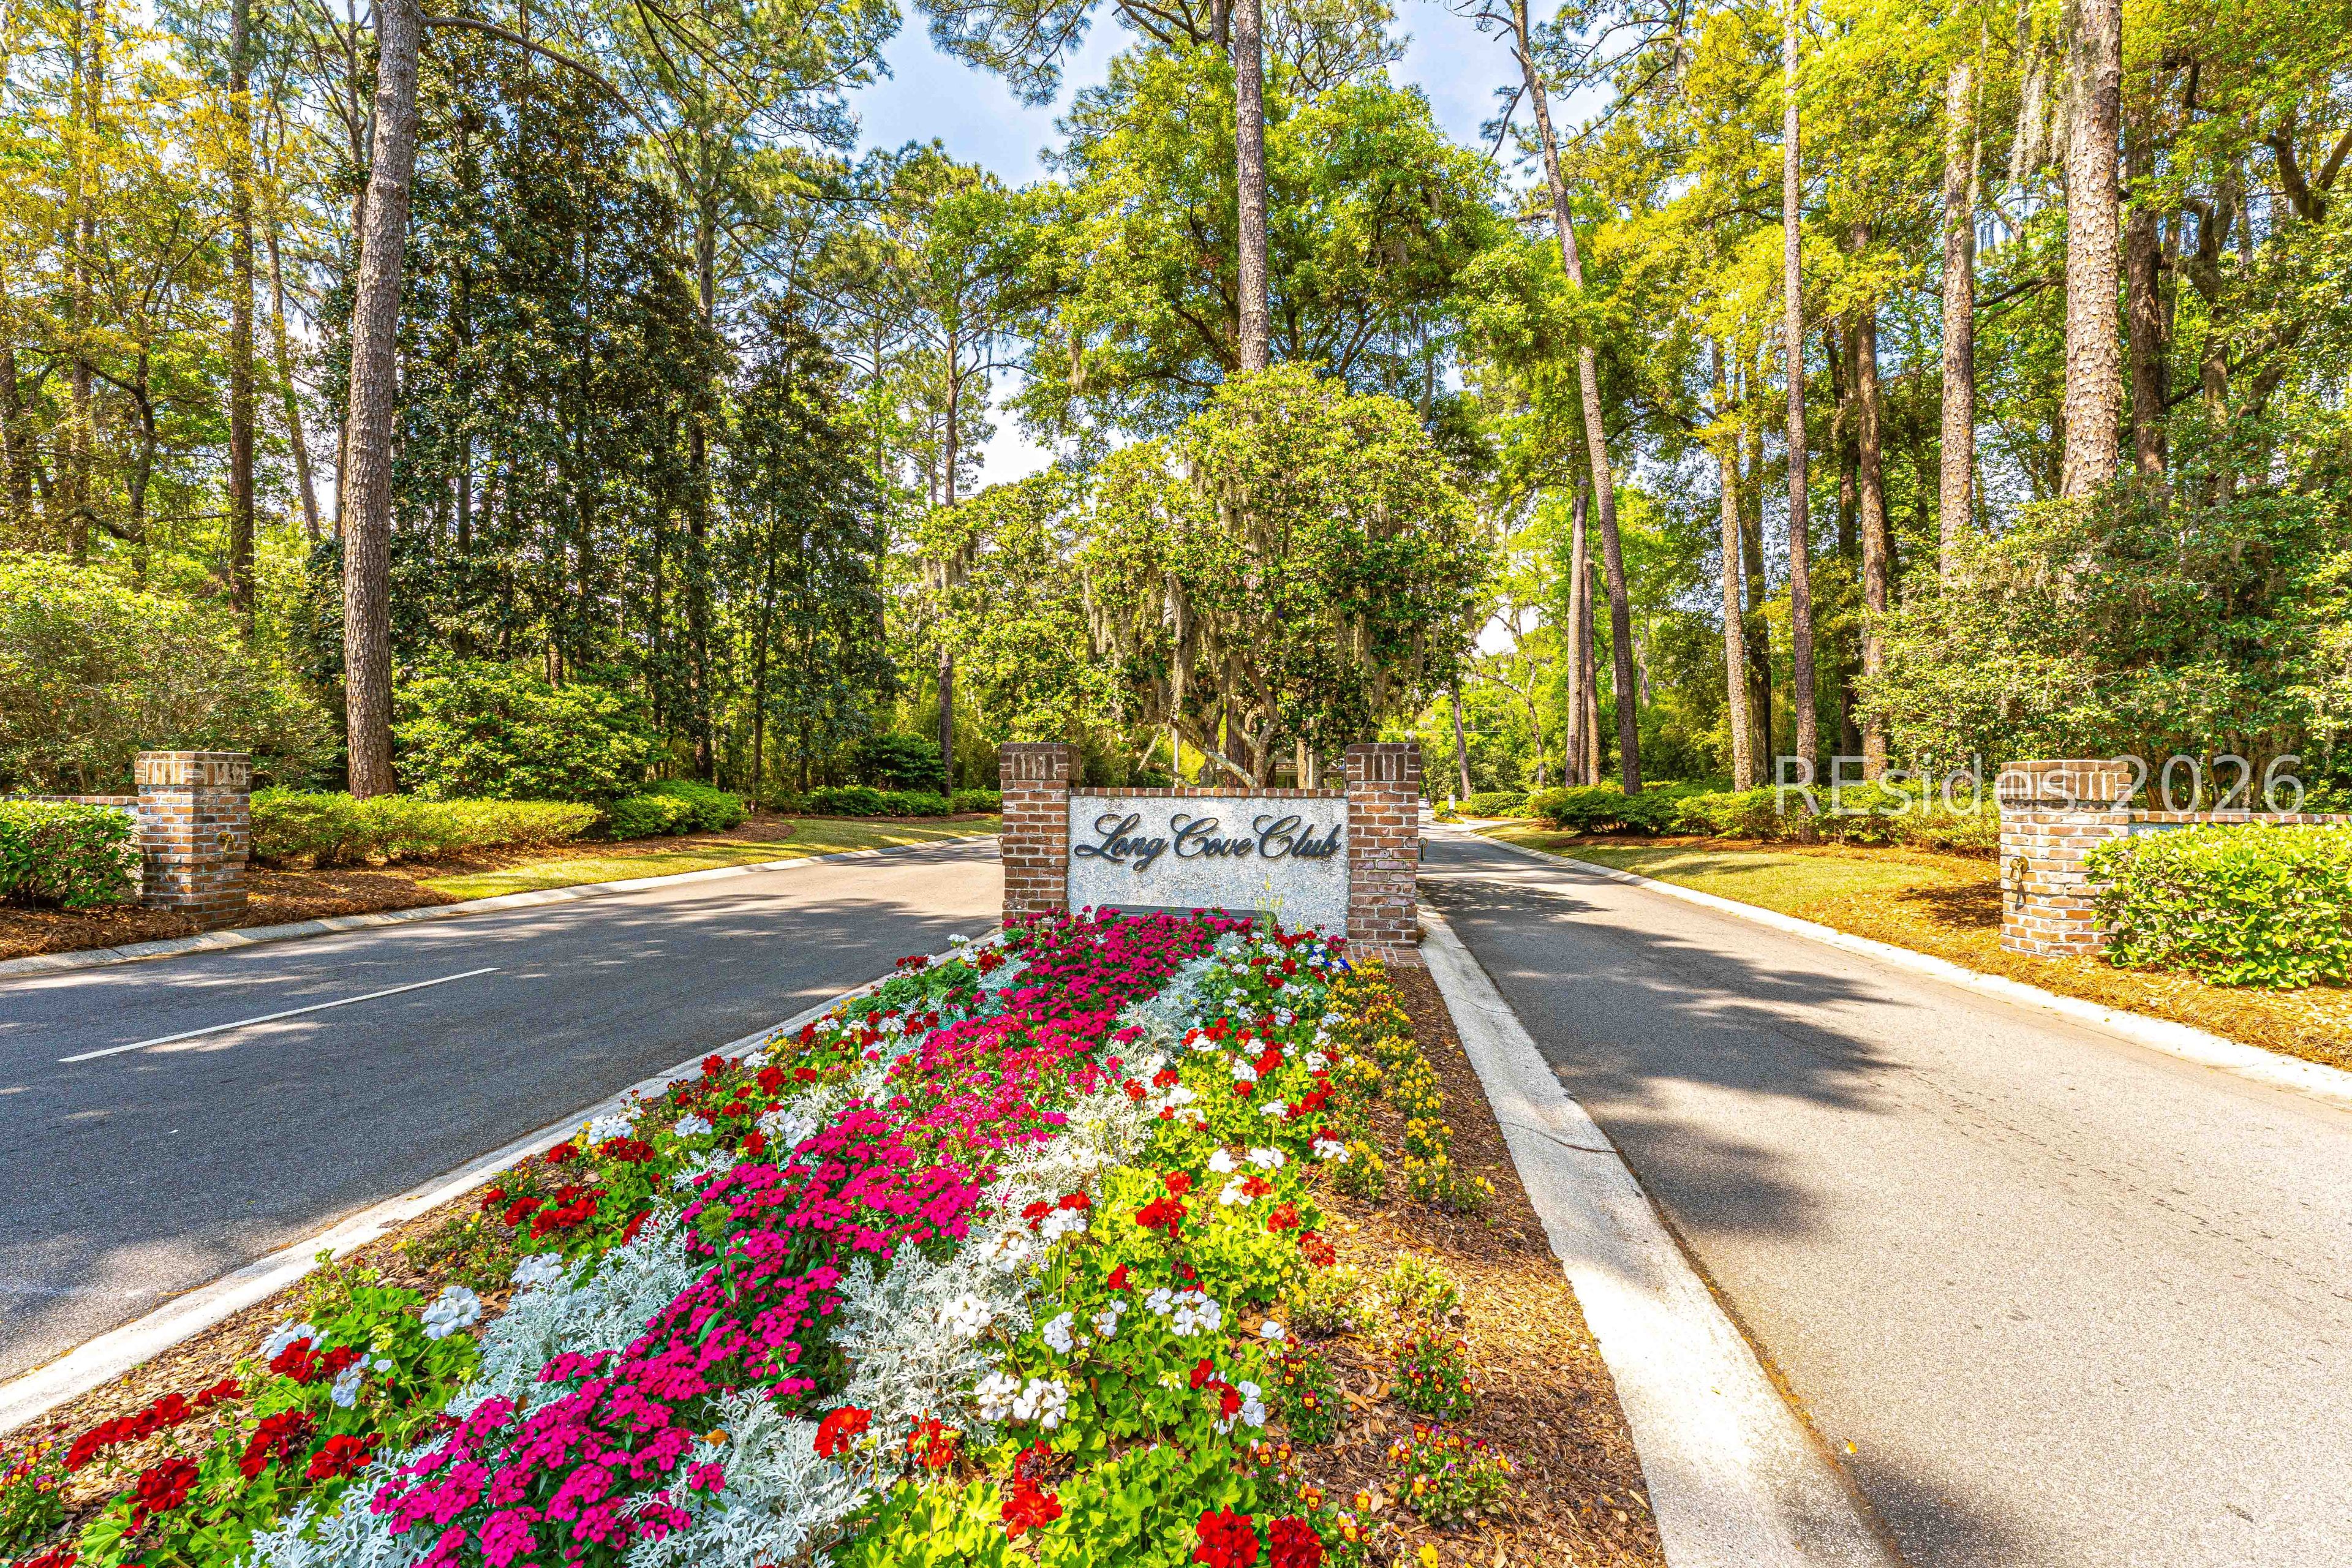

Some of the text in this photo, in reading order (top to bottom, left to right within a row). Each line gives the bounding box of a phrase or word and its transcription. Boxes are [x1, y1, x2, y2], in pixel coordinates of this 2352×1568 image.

[1074, 813, 1342, 871] Long Cove Club
